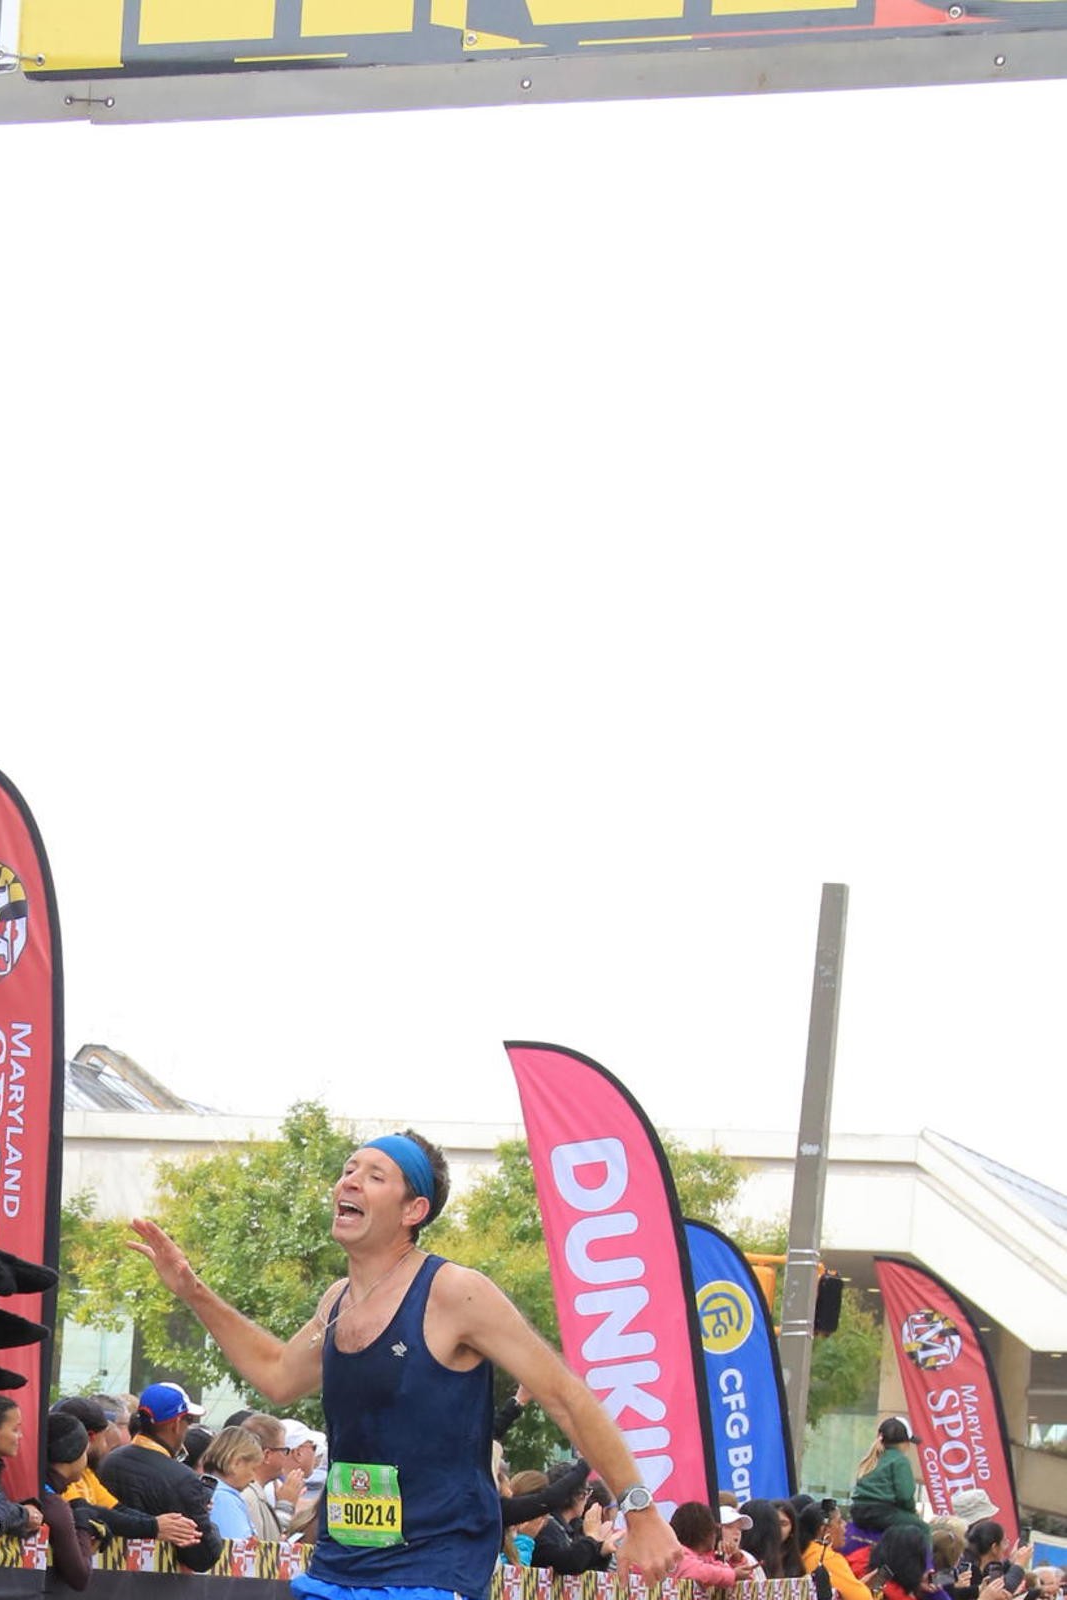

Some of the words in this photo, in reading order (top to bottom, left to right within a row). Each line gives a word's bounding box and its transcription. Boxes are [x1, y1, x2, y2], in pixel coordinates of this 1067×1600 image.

[3, 1020, 32, 1219] MARYLAND
[719, 1368, 750, 1439] CFG
[960, 1385, 991, 1480] MARYLAND
[344, 1503, 397, 1527] 90214
